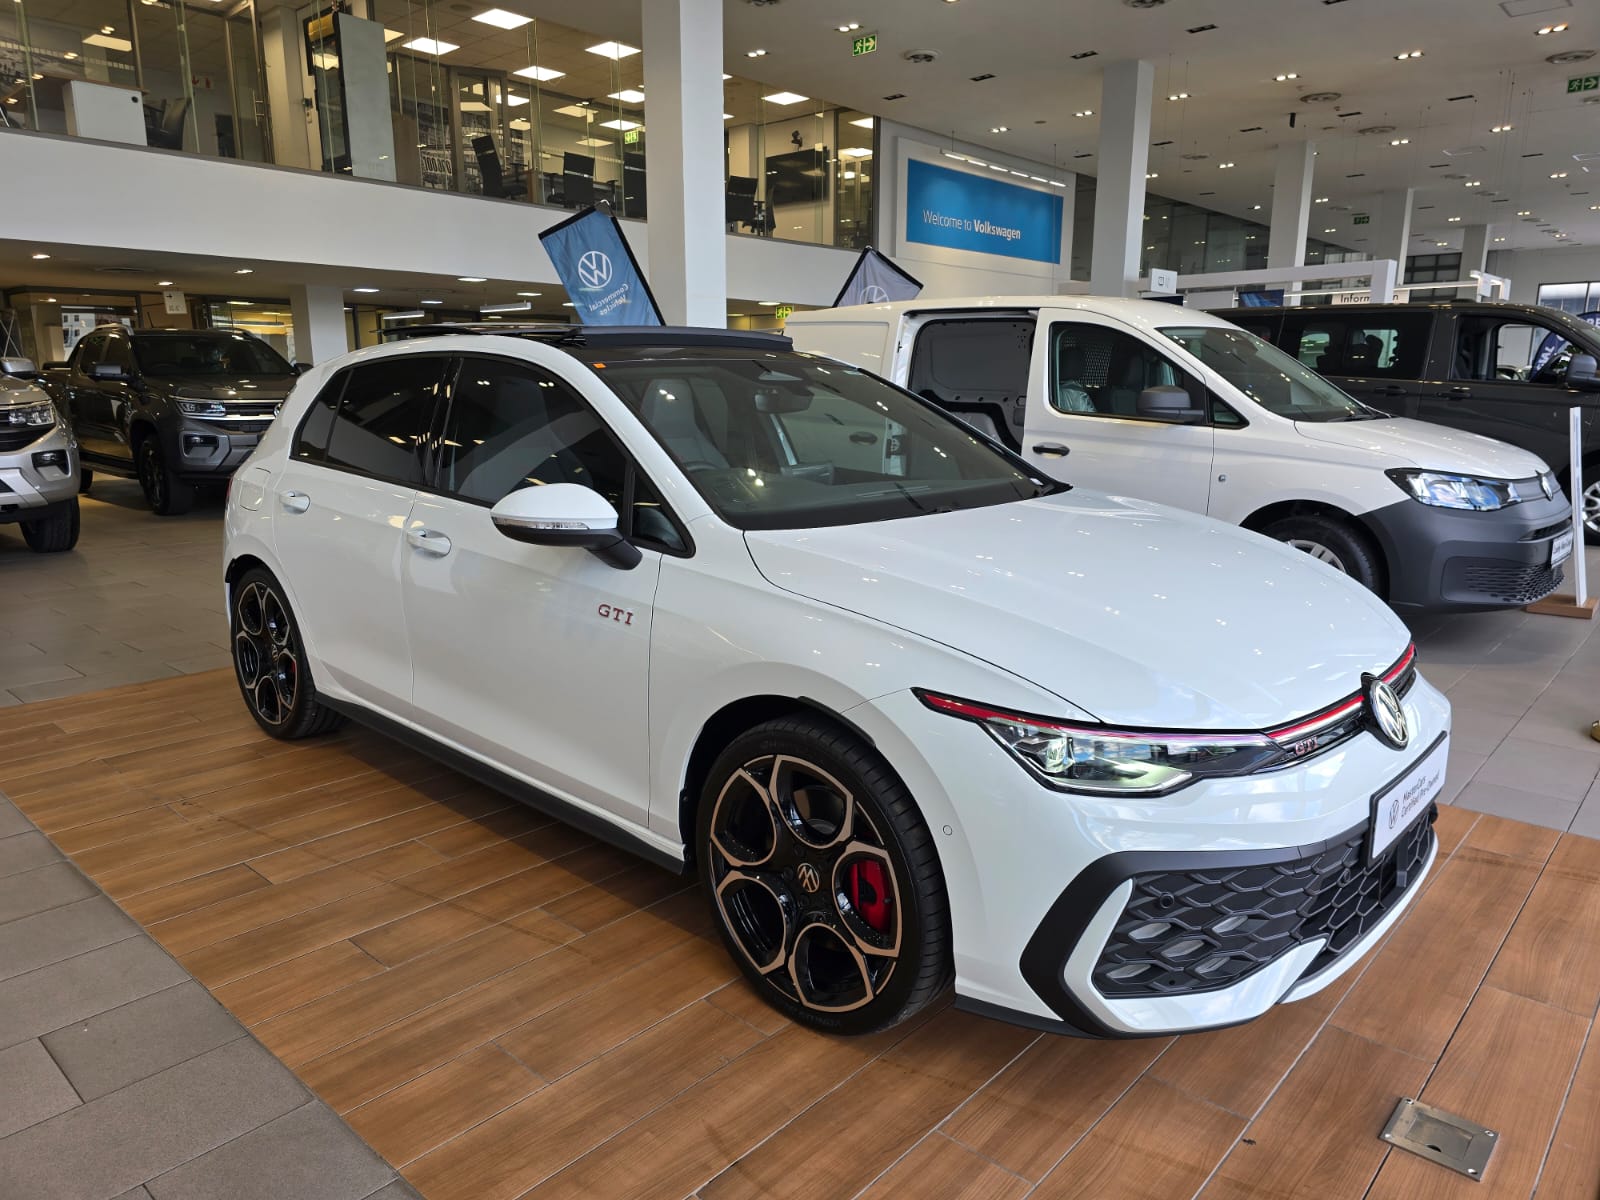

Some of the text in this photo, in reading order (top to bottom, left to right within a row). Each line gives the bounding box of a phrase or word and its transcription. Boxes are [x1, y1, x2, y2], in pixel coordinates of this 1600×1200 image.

[923, 207, 1021, 241] Welcome to Volkswagen
[1341, 292, 1399, 303] Informn
[598, 603, 634, 625] GTI
[1295, 736, 1319, 756] GTI
